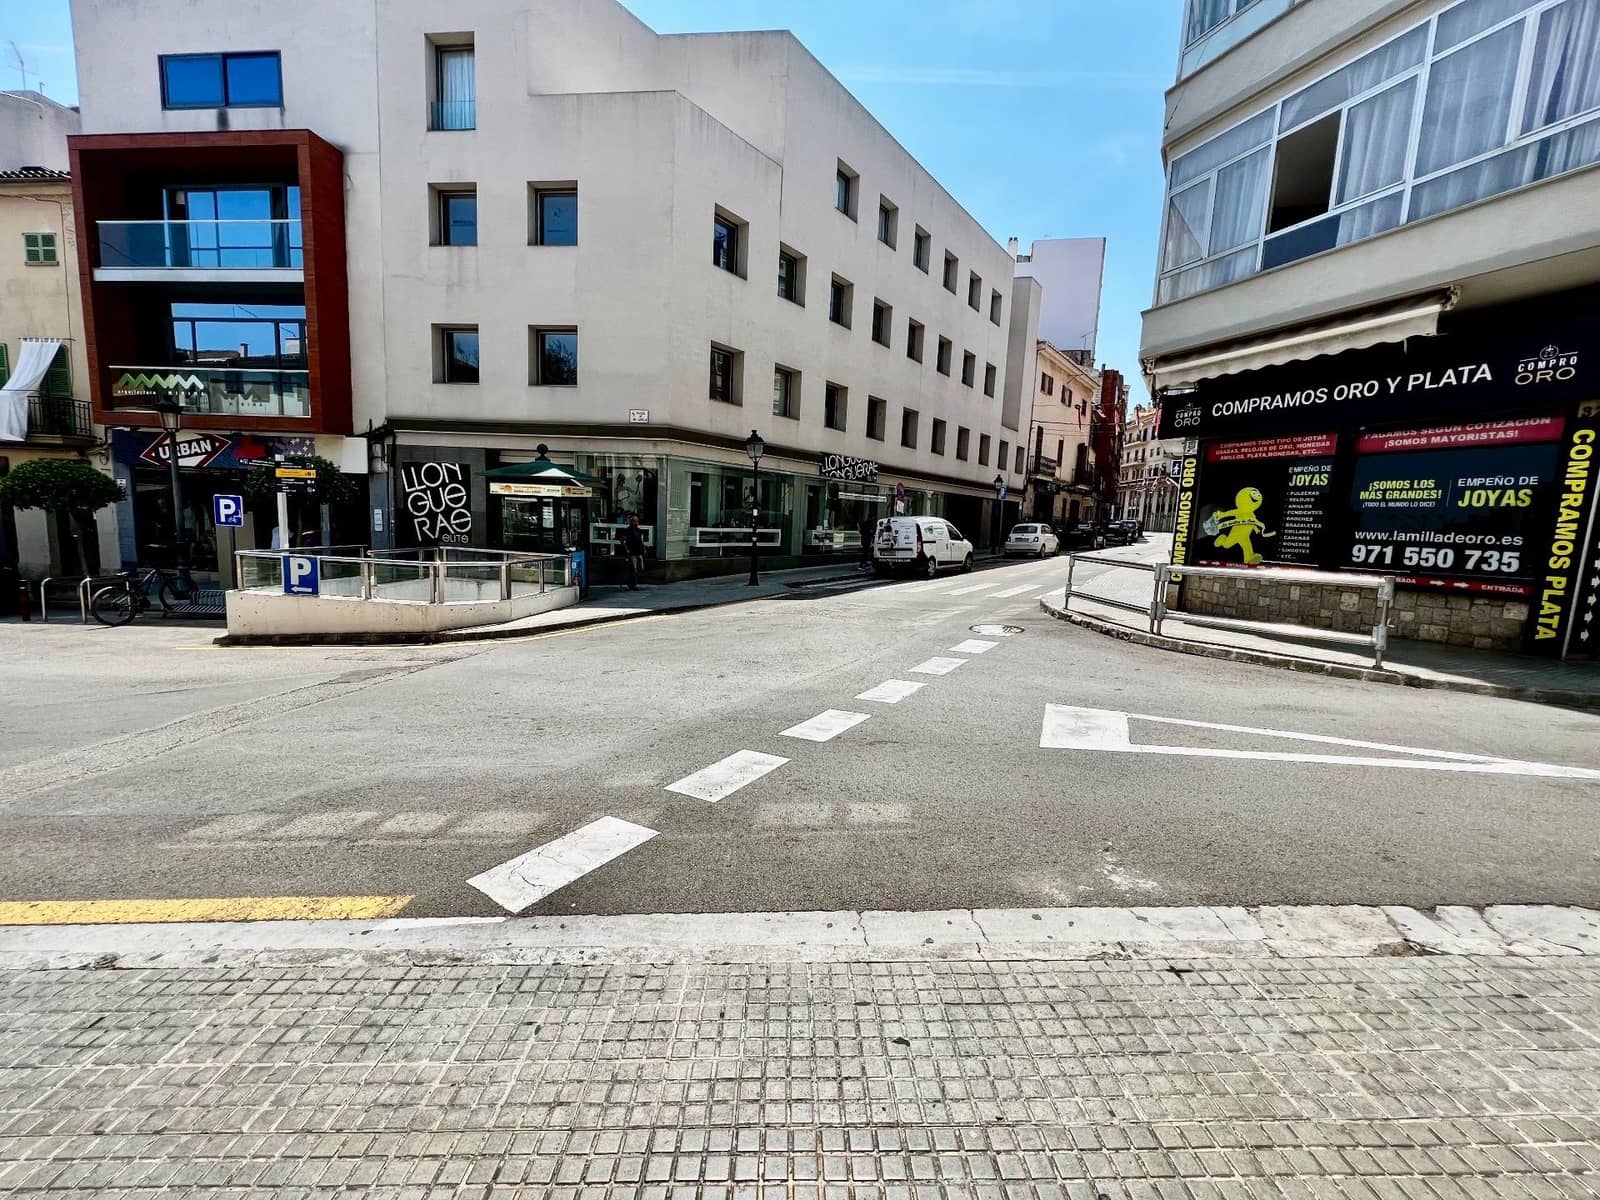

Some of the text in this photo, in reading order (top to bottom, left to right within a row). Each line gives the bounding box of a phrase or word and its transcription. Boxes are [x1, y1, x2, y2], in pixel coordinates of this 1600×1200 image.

[1518, 355, 1578, 372] COMPRO
[1515, 367, 1575, 385] ORO
[1212, 363, 1493, 417] COMPRAMOS ORO Y PLATA
[1174, 416, 1200, 428] ORO
[1384, 430, 1519, 448] ¡SOMOS MAYORISTAS!
[158, 439, 212, 459] URBAN
[401, 462, 462, 493] LLON
[1288, 474, 1328, 487] JOYAS
[1369, 479, 1435, 491] ¡SOMOS LOS
[1458, 475, 1539, 487] EMPEÑO DE
[1386, 489, 1442, 499] GRANDES!
[1458, 489, 1533, 507] JOYAS
[219, 499, 236, 523] P
[1170, 457, 1196, 582] CMPRAMOS ORO
[1355, 530, 1524, 546] www.lamilladeoro.es
[1535, 429, 1596, 640] COMPRAMOS PLATA
[1351, 544, 1520, 573] 971 550 735
[289, 557, 311, 585] P
